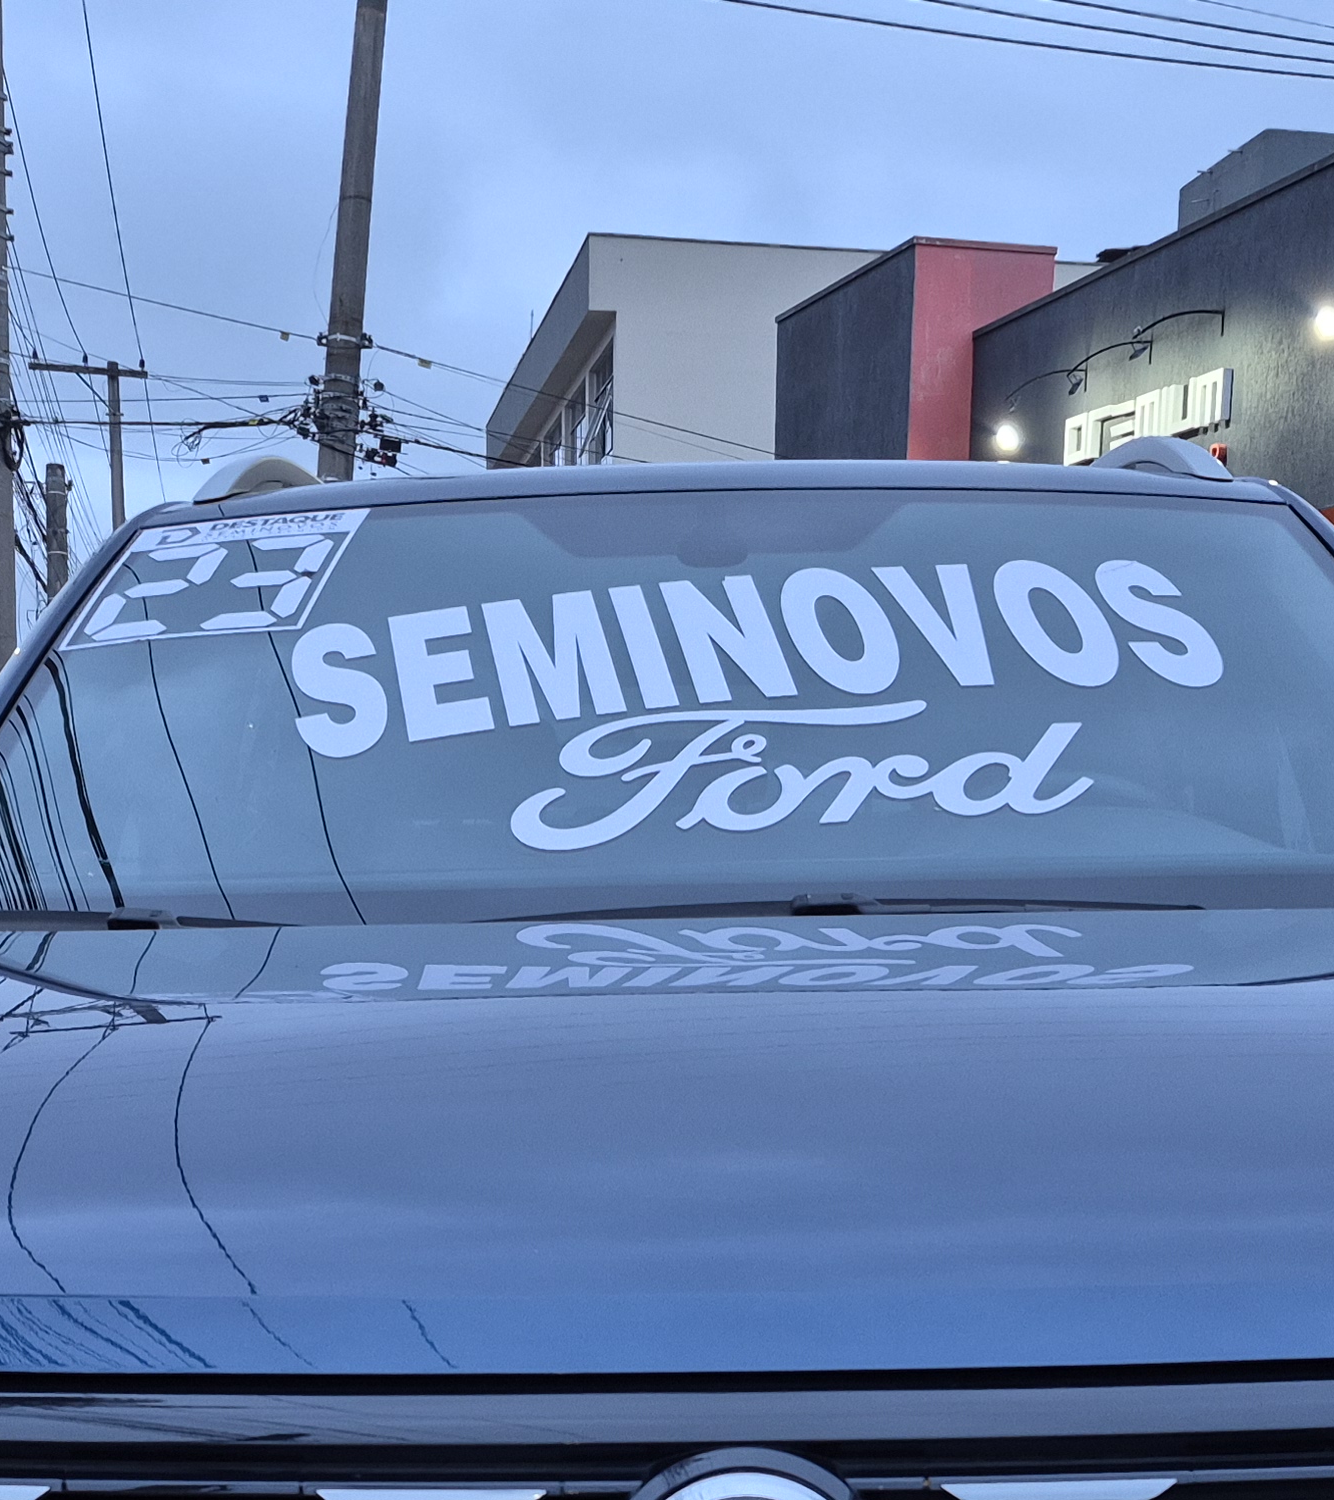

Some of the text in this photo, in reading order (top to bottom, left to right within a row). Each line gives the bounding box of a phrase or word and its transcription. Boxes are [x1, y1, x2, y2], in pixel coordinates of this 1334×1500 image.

[209, 512, 346, 532] DESTAQUE
[290, 559, 1224, 758] SEMINOVOS
[509, 700, 1095, 852] Ford
